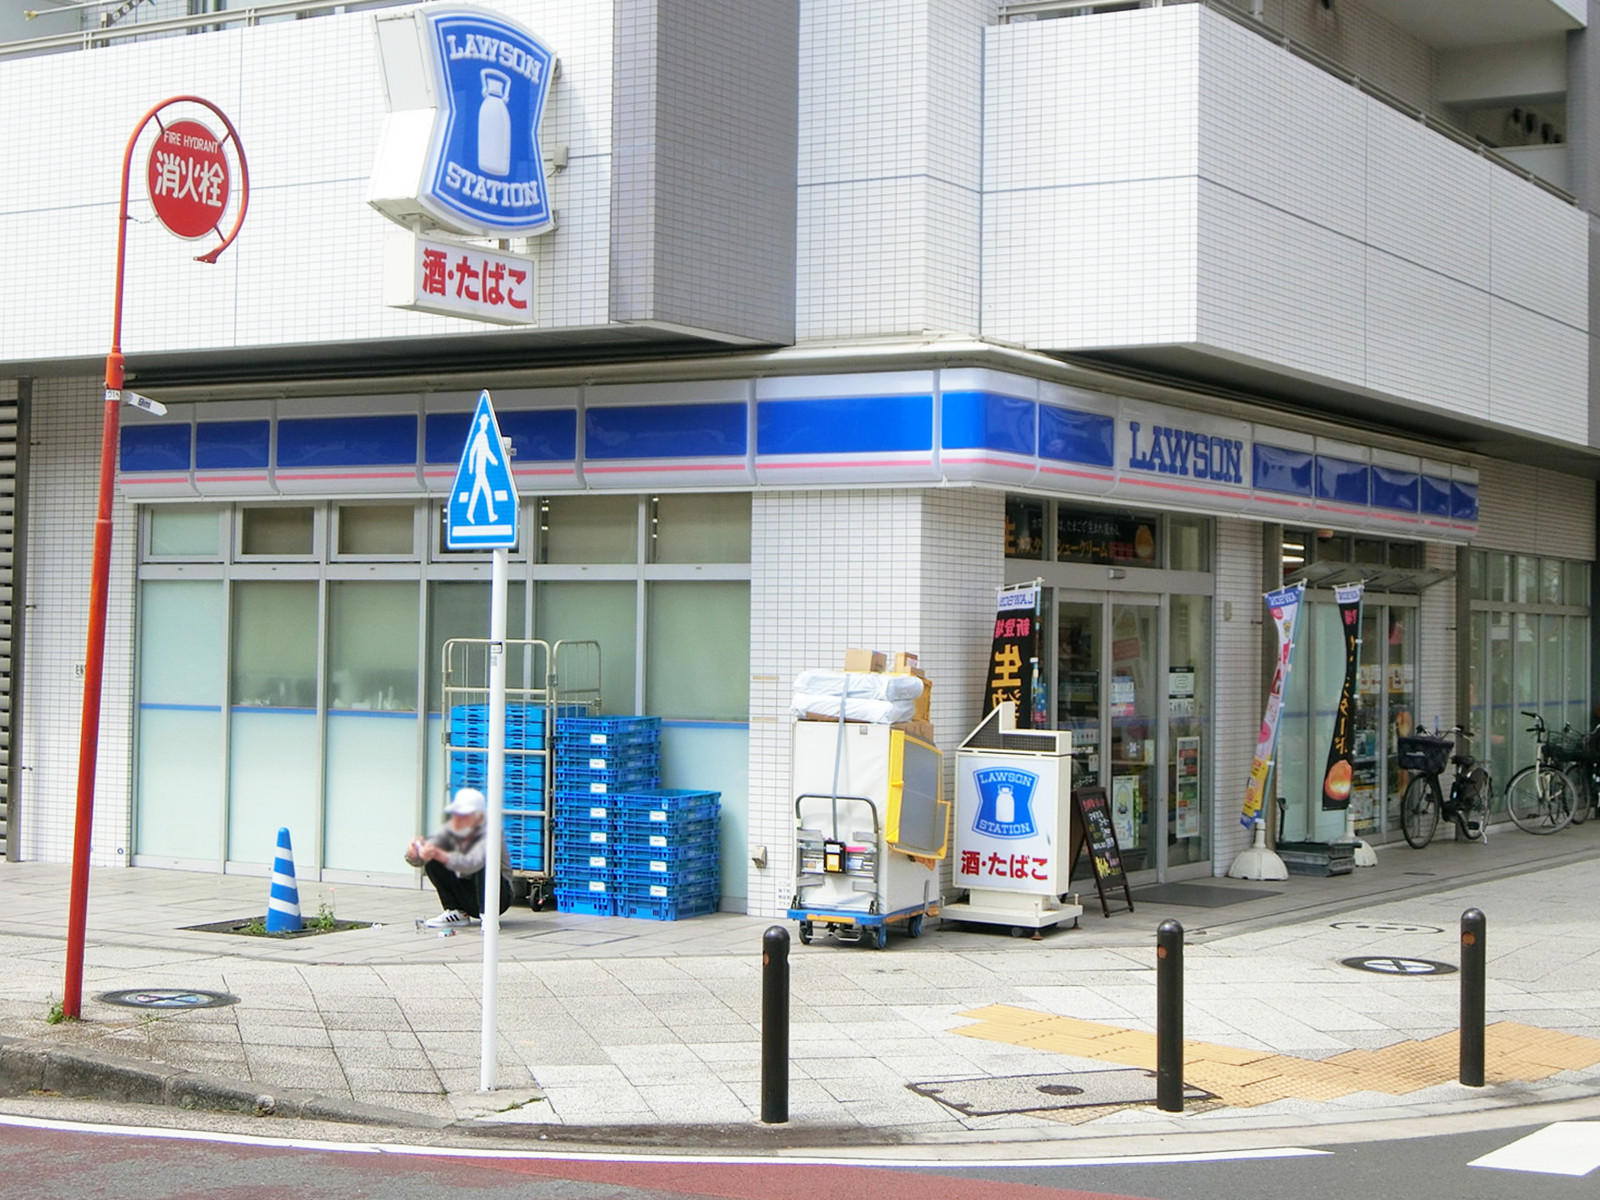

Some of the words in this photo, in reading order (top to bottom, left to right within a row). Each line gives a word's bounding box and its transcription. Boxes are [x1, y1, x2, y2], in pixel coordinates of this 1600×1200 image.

[447, 34, 542, 84] LAWSON
[163, 131, 182, 146] FIRE
[184, 135, 219, 154] HYDRANT
[155, 150, 225, 207] 消火栓
[445, 161, 540, 207] STATION
[422, 247, 527, 310] 酒・たばこ
[1129, 420, 1243, 484] LAWSON
[980, 771, 1033, 787] LAWSON
[979, 819, 1031, 835] STATION
[961, 849, 1048, 881] 酒・たばこ
